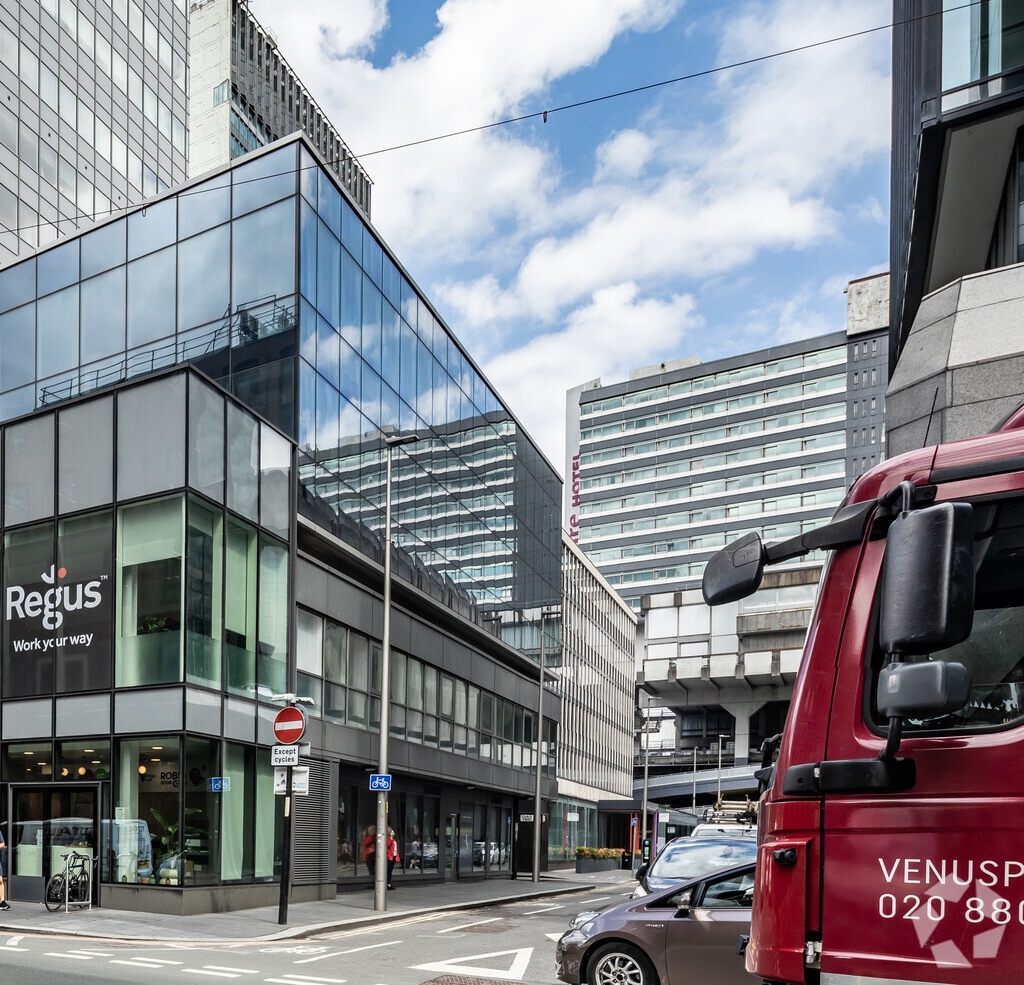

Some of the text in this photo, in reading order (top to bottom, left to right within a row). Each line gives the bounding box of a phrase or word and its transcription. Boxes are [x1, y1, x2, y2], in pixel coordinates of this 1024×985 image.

[571, 449, 582, 508] HOTEL
[6, 581, 102, 630] Regus
[13, 637, 42, 653] Work
[69, 633, 94, 647] way
[274, 748, 297, 757] Except
[274, 756, 295, 764] cycles
[878, 858, 1024, 887] VENUSP
[879, 893, 945, 921] 020
